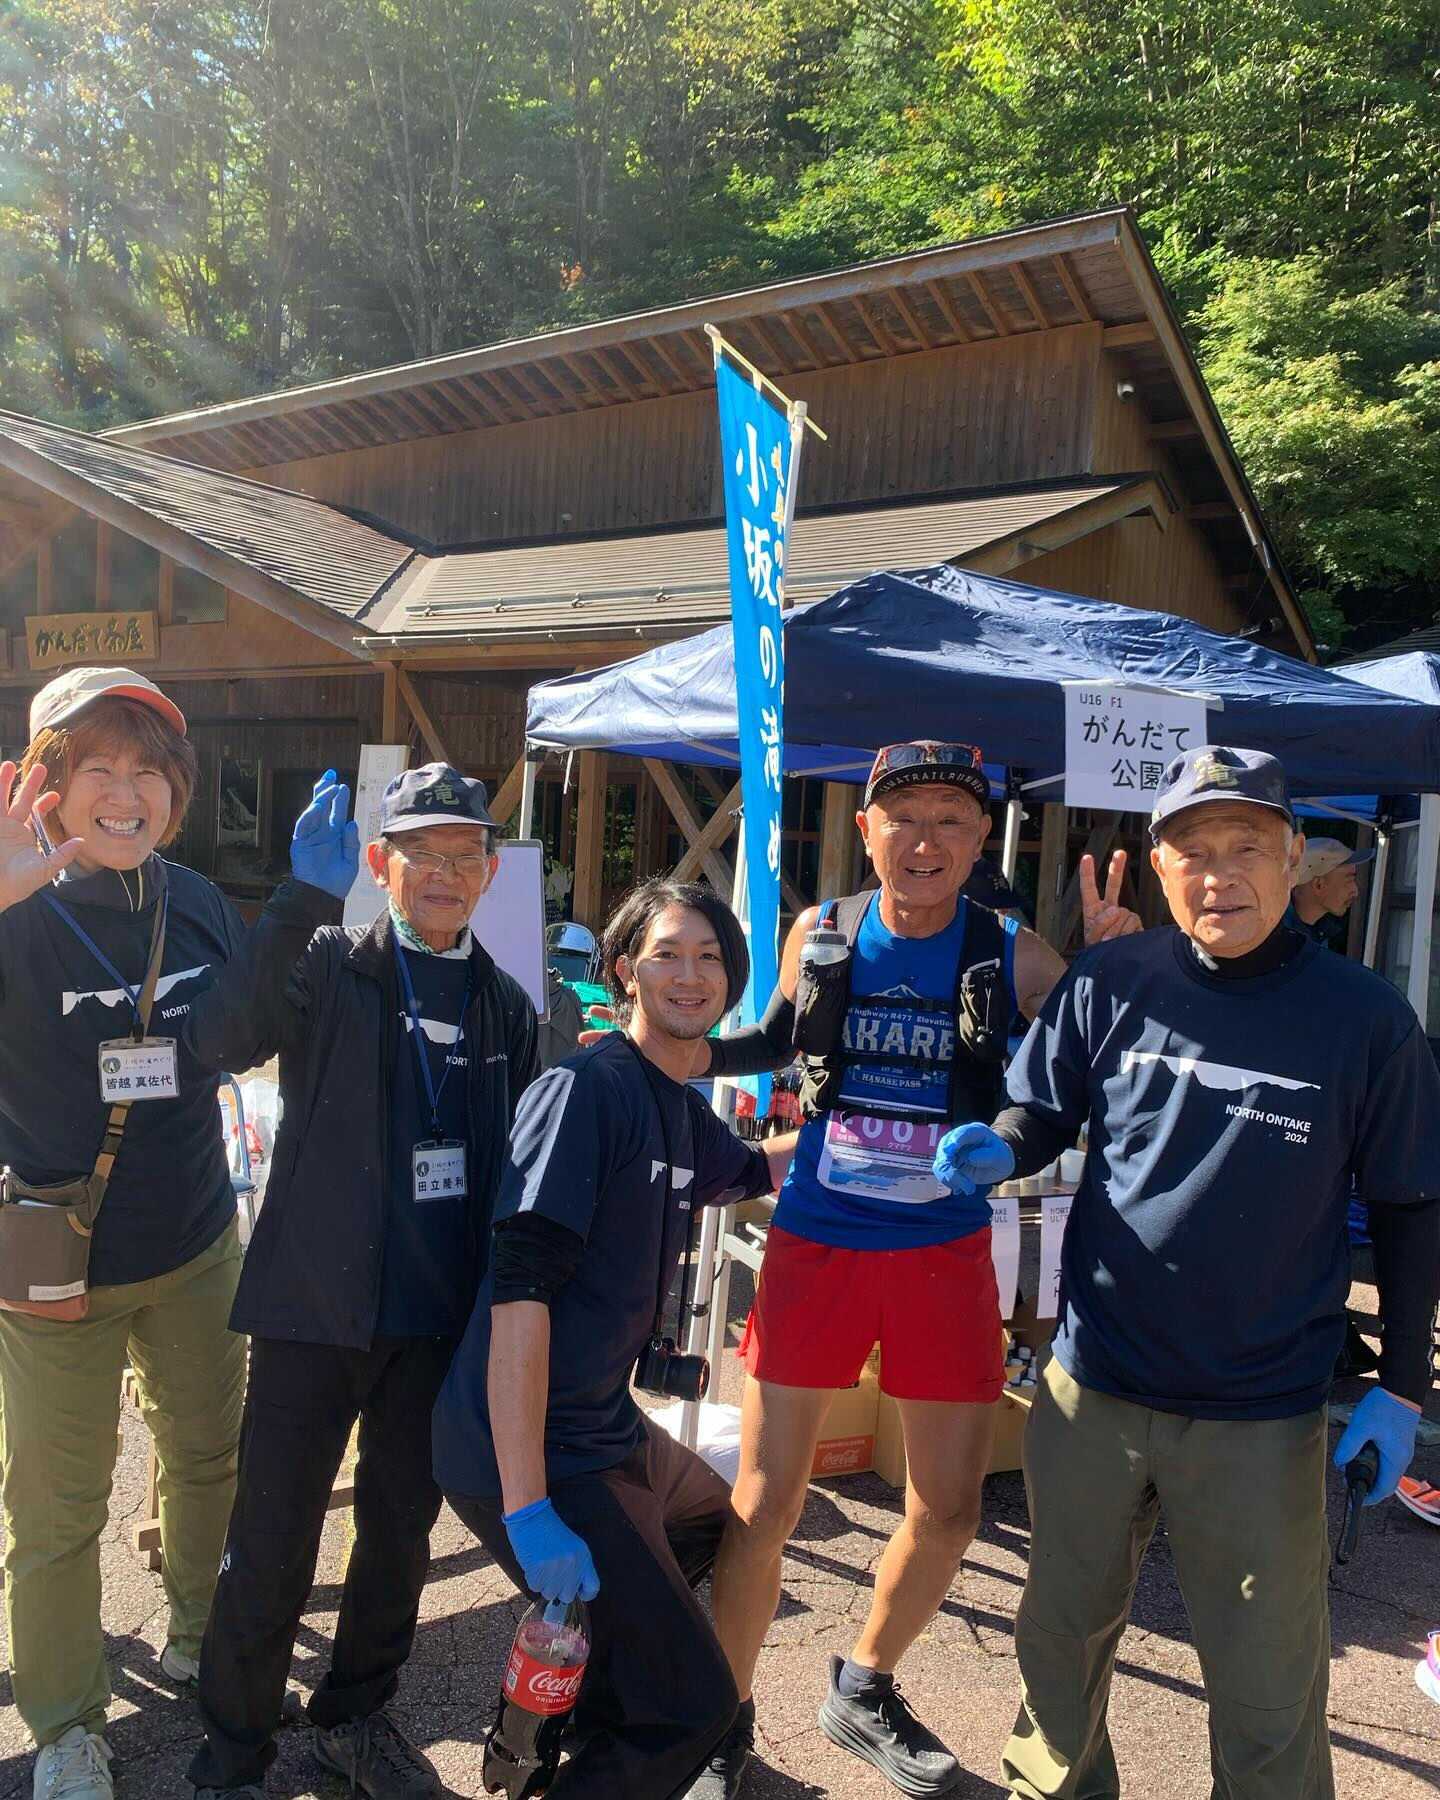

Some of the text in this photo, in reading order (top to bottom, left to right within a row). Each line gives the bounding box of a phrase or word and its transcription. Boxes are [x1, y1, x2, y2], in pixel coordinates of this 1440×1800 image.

[1080, 693, 1123, 708] U16 F1
[1082, 715, 1190, 751] がんだて
[1111, 758, 1164, 791] 公園
[1195, 763, 1238, 787] 滝
[424, 783, 460, 806] 滝
[135, 1074, 173, 1088] 真佐代
[1225, 1104, 1312, 1132] NORTH ONTAKE
[1284, 1132, 1308, 1144] 2024
